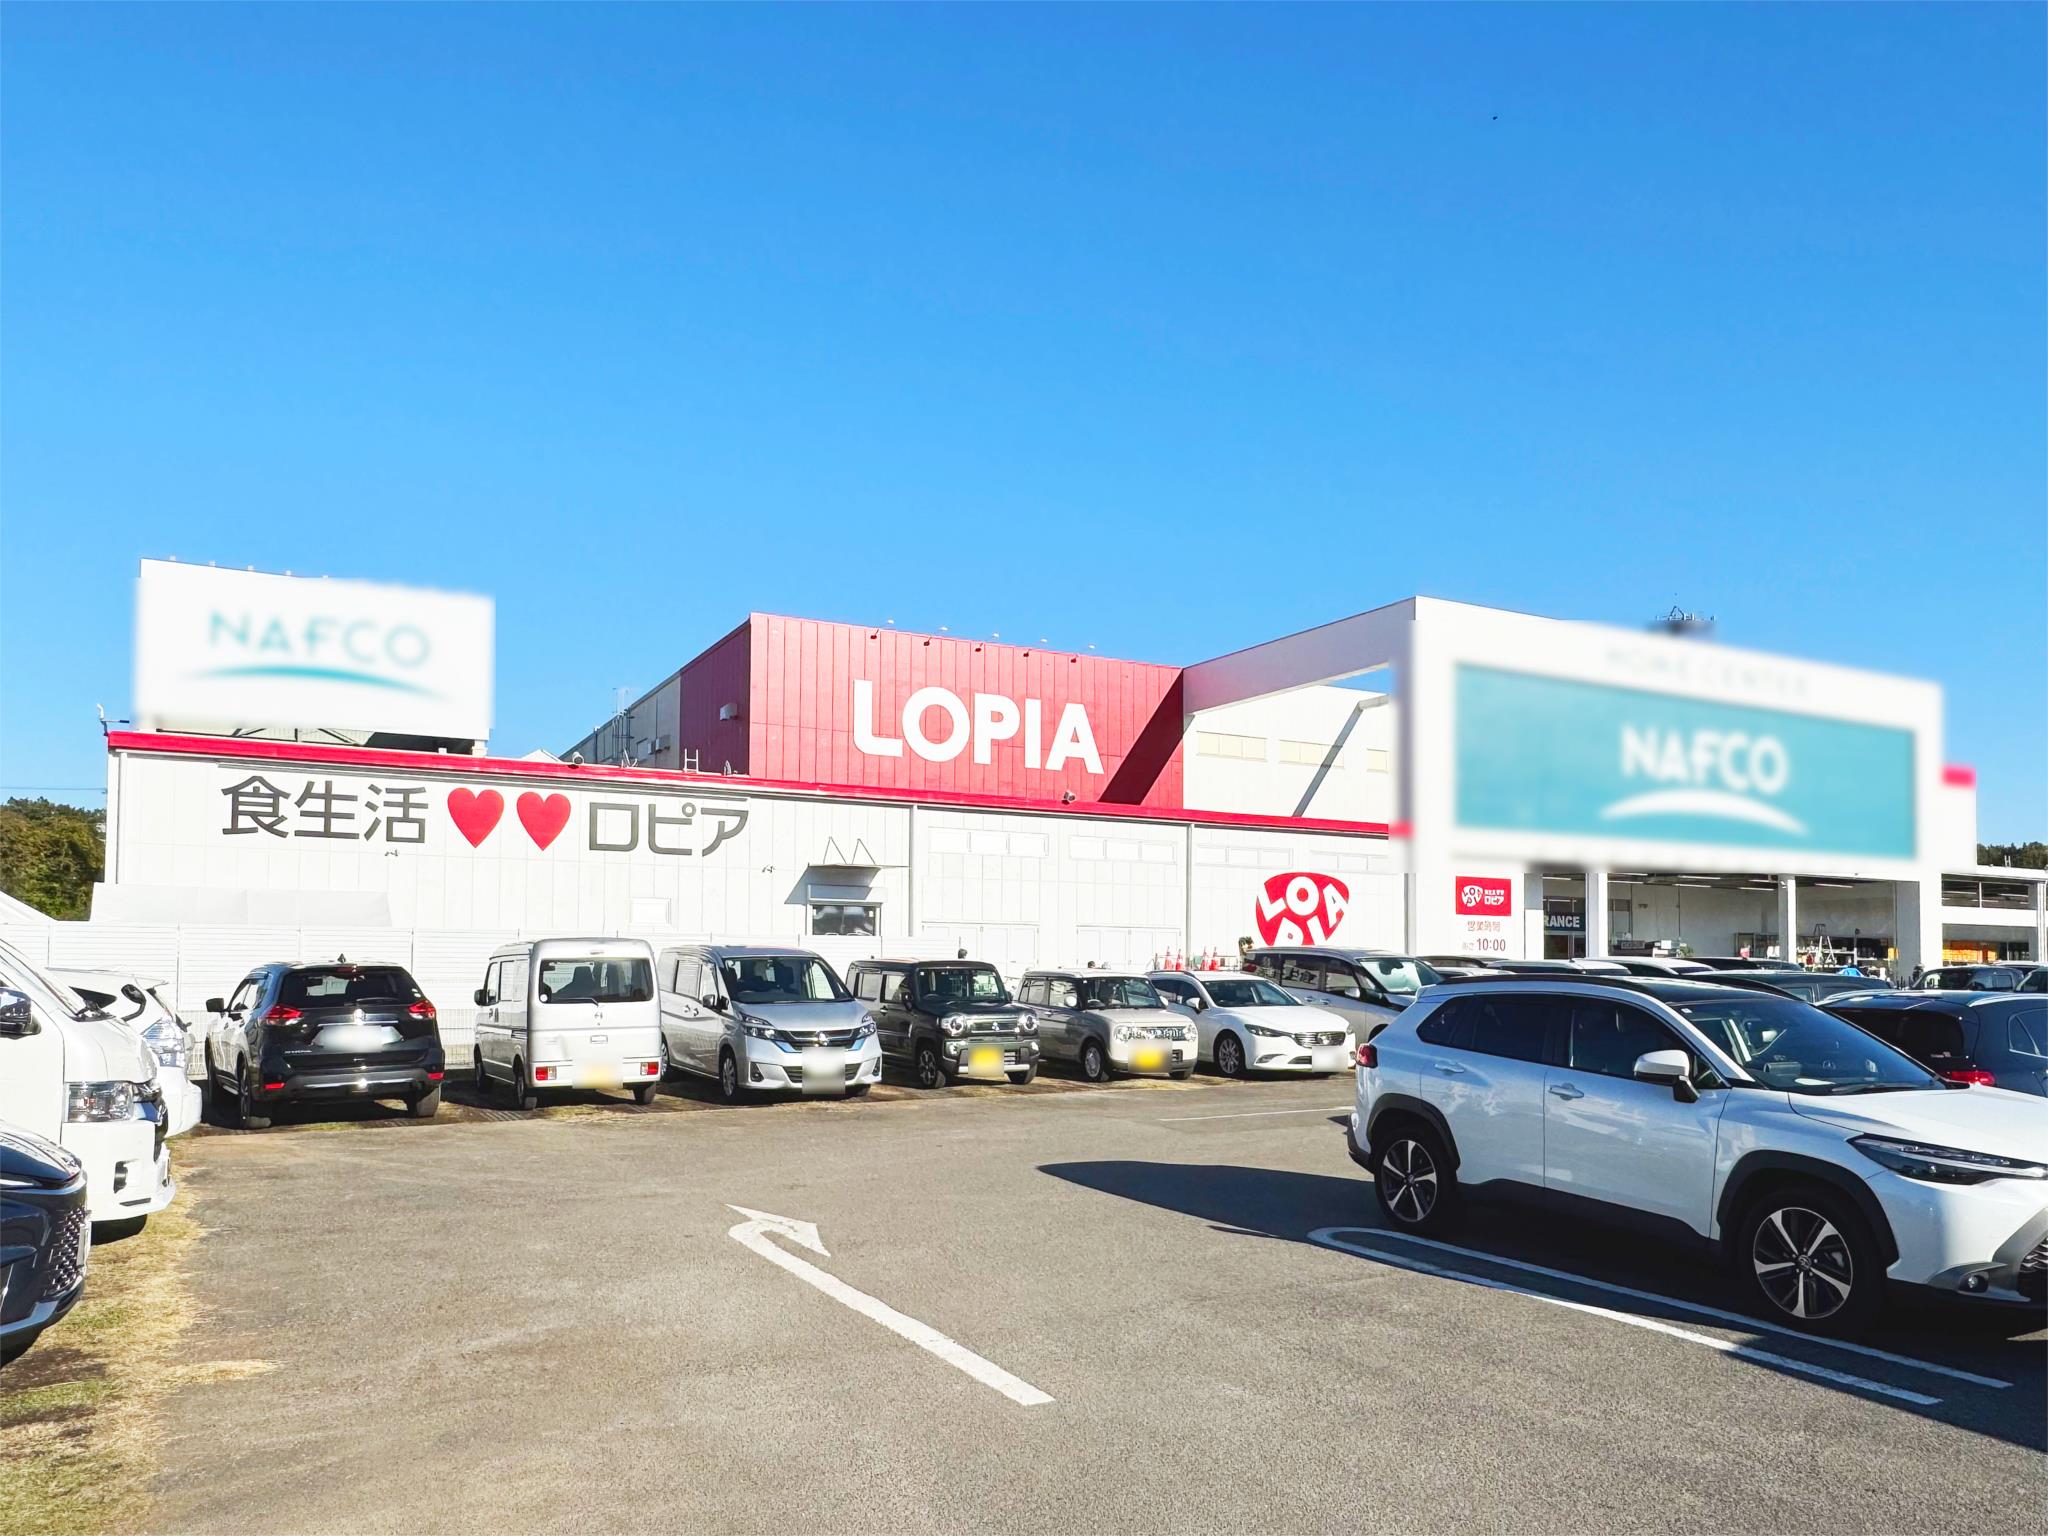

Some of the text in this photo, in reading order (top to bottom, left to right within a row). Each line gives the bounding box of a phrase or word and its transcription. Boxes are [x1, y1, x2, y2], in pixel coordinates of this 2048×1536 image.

[208, 609, 433, 669] NAFCO
[853, 679, 1105, 775] LOPIA
[1620, 724, 1788, 796] NAFCO
[221, 775, 750, 857] 食生活 ロピア
[1476, 938, 1506, 952] 10:00
